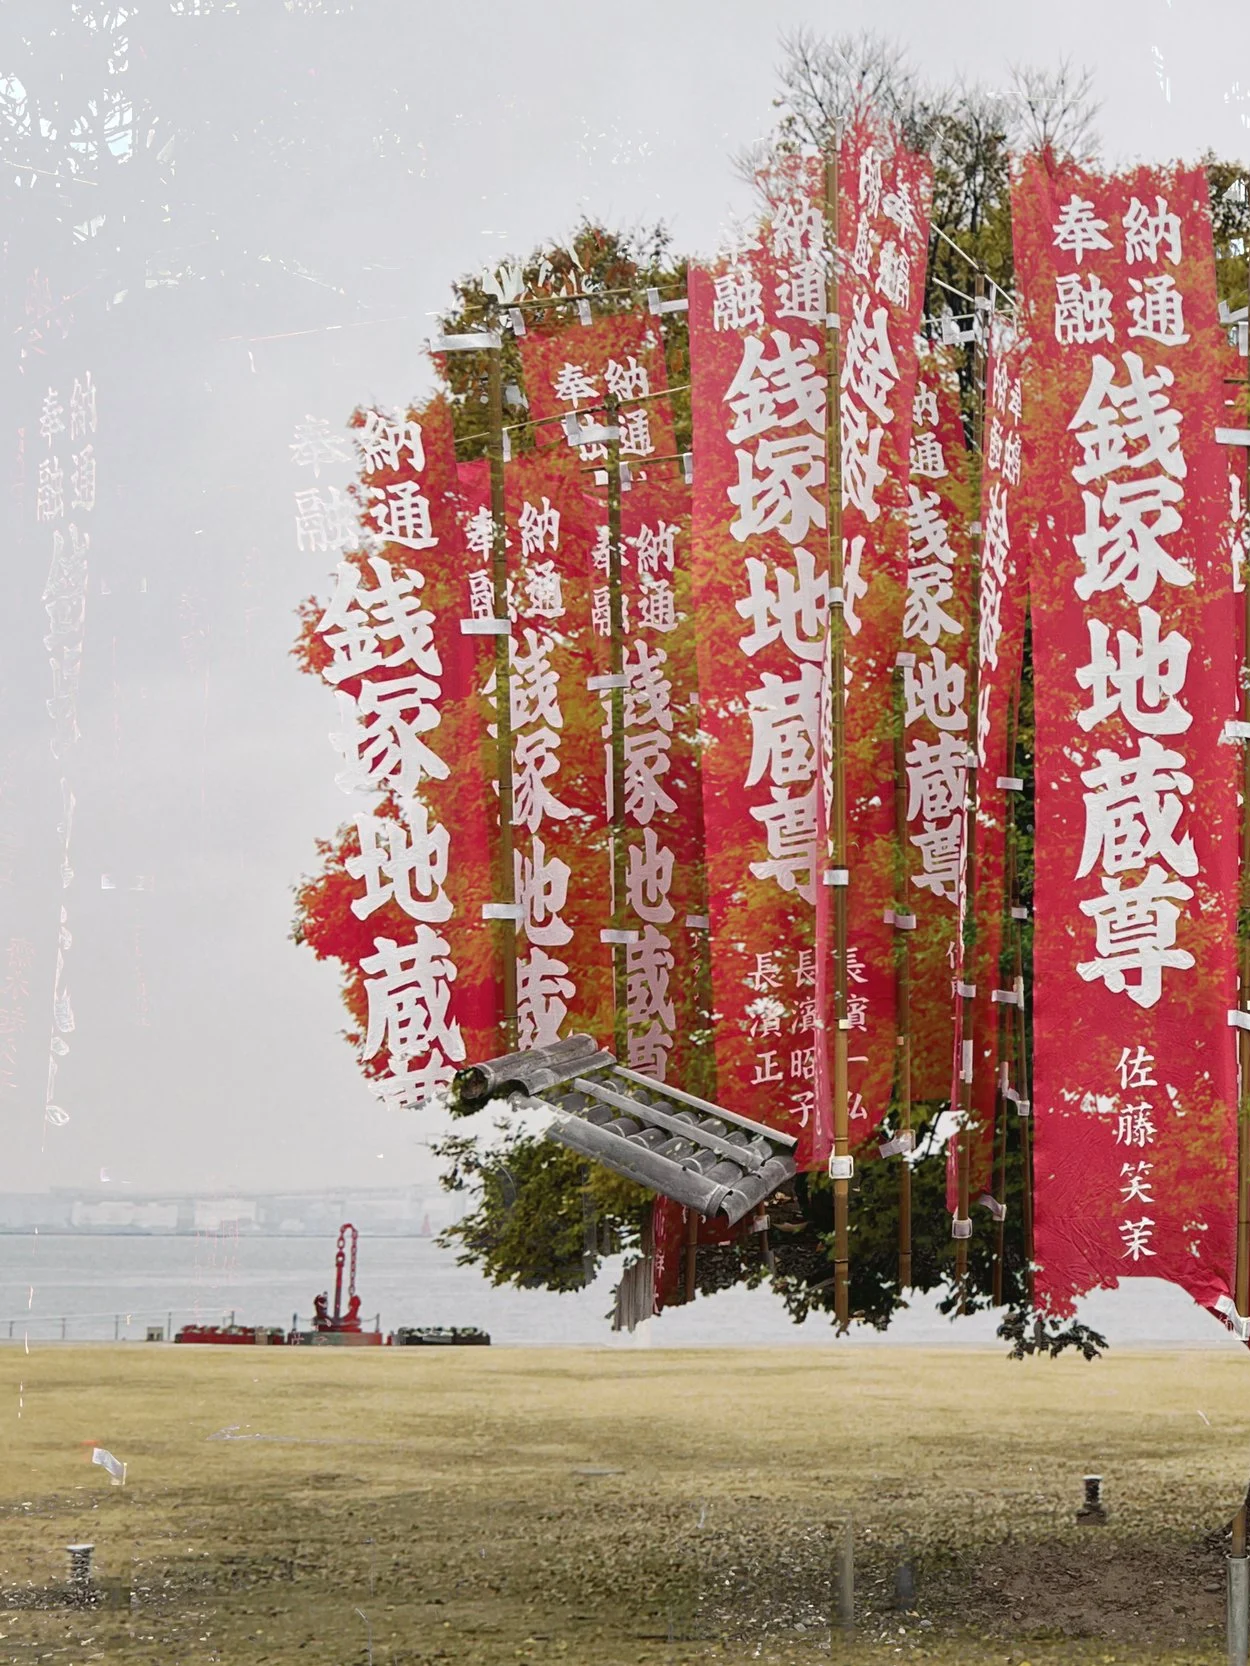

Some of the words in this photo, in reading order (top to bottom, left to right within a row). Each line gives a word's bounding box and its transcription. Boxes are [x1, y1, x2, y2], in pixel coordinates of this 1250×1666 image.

[1052, 194, 1184, 266] 奉納
[713, 260, 828, 332] 融通
[1054, 272, 1190, 347] 融通
[554, 355, 650, 409] 奉納
[723, 329, 832, 905] 銭塚地蔵尊
[1066, 350, 1201, 1009] 銭塚地蔵尊
[1112, 1045, 1160, 1262] 佐藤笑茉
